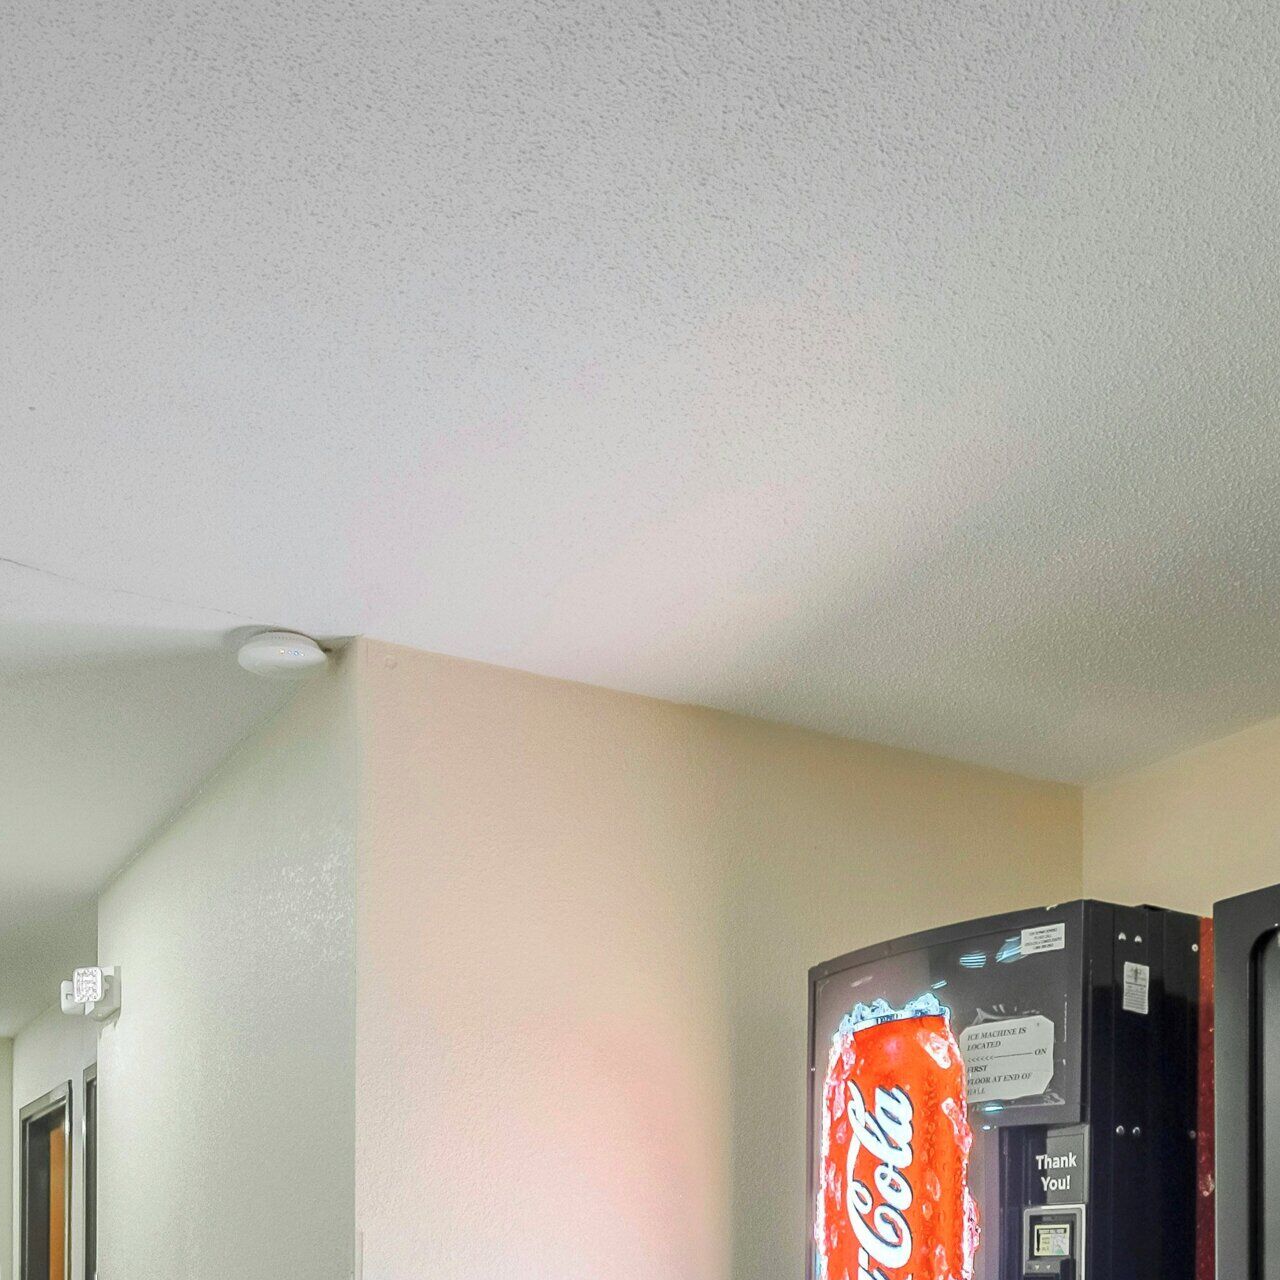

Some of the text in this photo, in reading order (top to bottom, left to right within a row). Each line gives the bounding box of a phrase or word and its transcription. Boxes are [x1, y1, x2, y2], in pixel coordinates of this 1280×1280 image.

[981, 1027, 1017, 1039] MACHINE
[967, 1040, 1001, 1051] LOCATED
[967, 1065, 988, 1073] FIRST
[967, 1077, 991, 1085] FLOOR
[1003, 1073, 1020, 1082] END
[1035, 1152, 1077, 1170] Thank
[1041, 1174, 1071, 1191] You!
